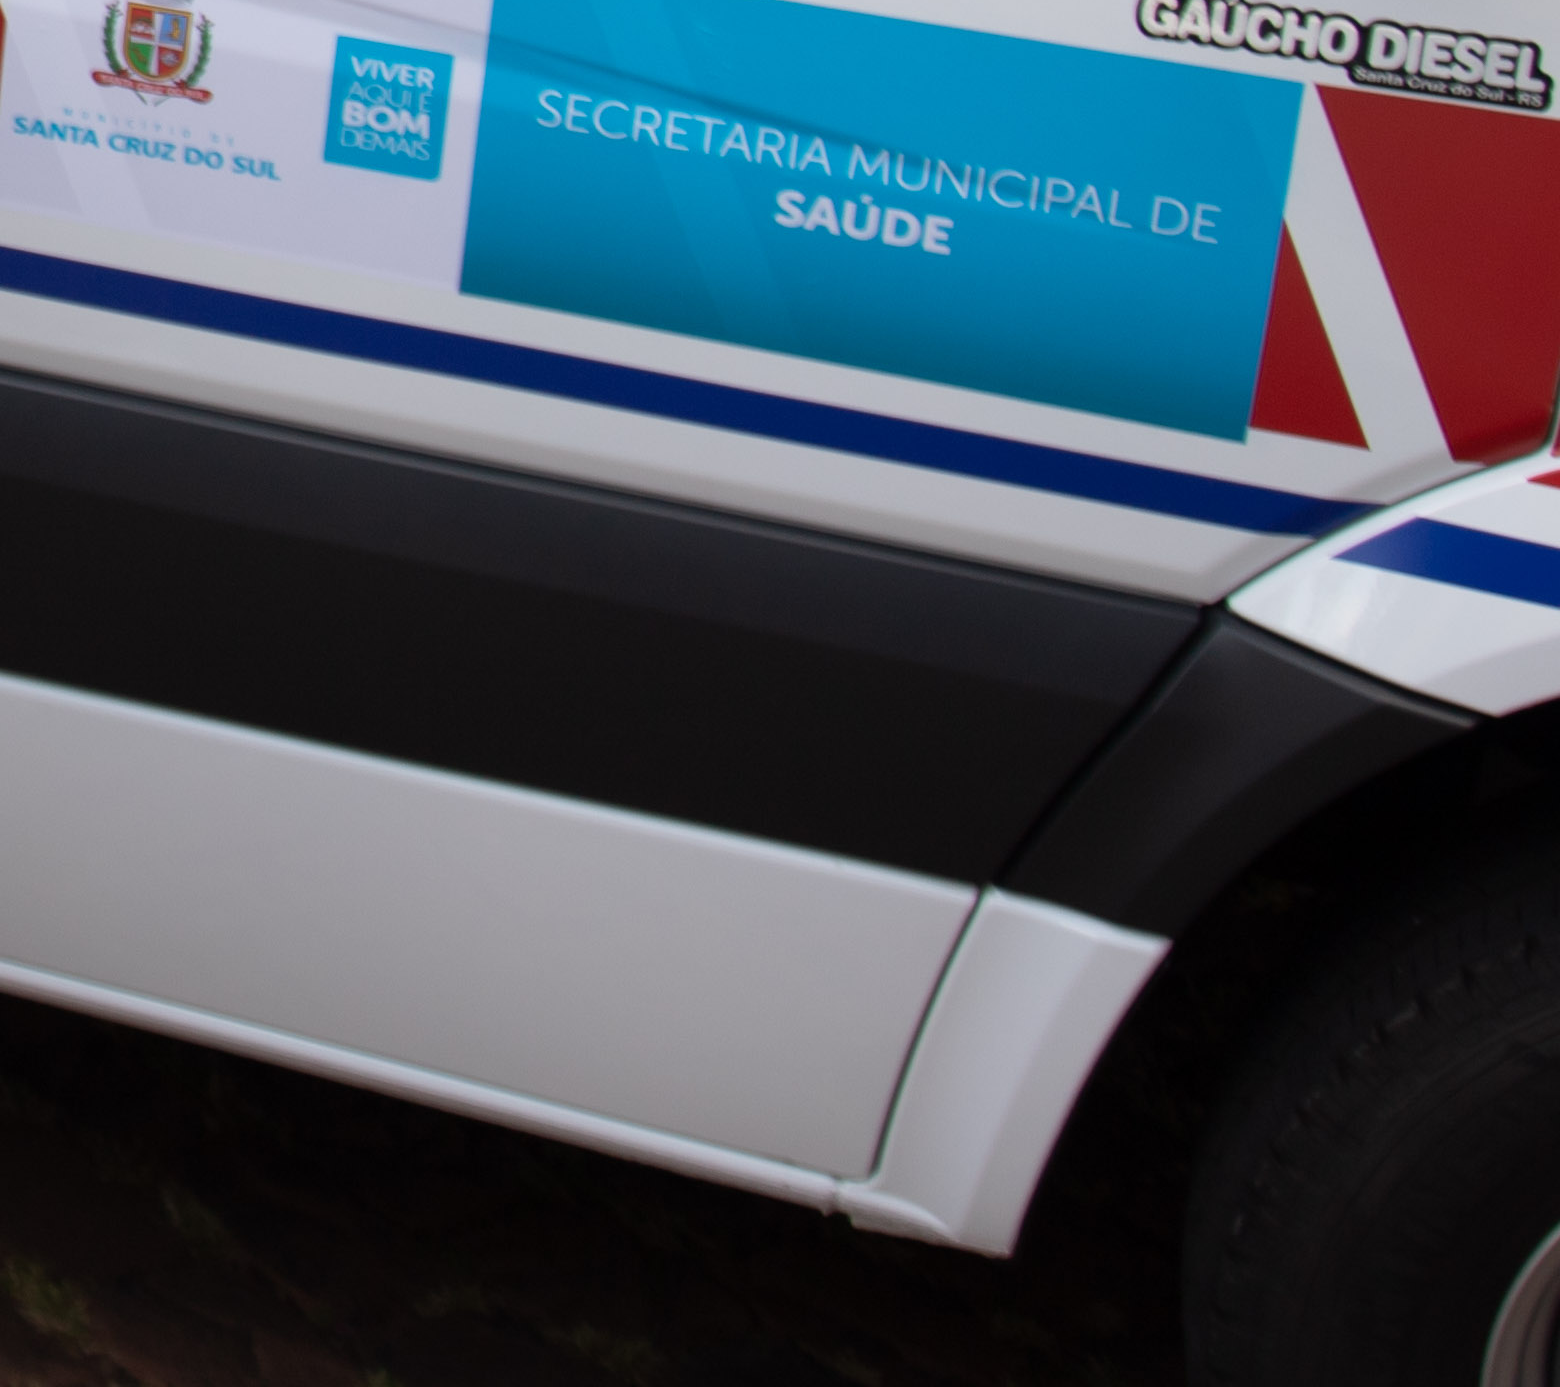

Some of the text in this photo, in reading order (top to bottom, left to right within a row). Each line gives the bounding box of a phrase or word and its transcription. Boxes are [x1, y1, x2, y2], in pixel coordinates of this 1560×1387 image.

[350, 55, 435, 90] VIVER
[1366, 23, 1547, 94] DIESEL
[348, 81, 412, 108] AQUI
[1353, 65, 1404, 87] Santa
[1408, 74, 1448, 95] Cruz
[1450, 82, 1471, 97] do
[1476, 85, 1504, 102] Sul
[342, 99, 430, 140] BOM
[13, 116, 282, 181] SANTA CRUZ DO SUL
[340, 127, 432, 161] DEMAIS
[536, 89, 1222, 245] SECRETARIA MUNICIPAL DE
[774, 188, 955, 256] SAÚDE
